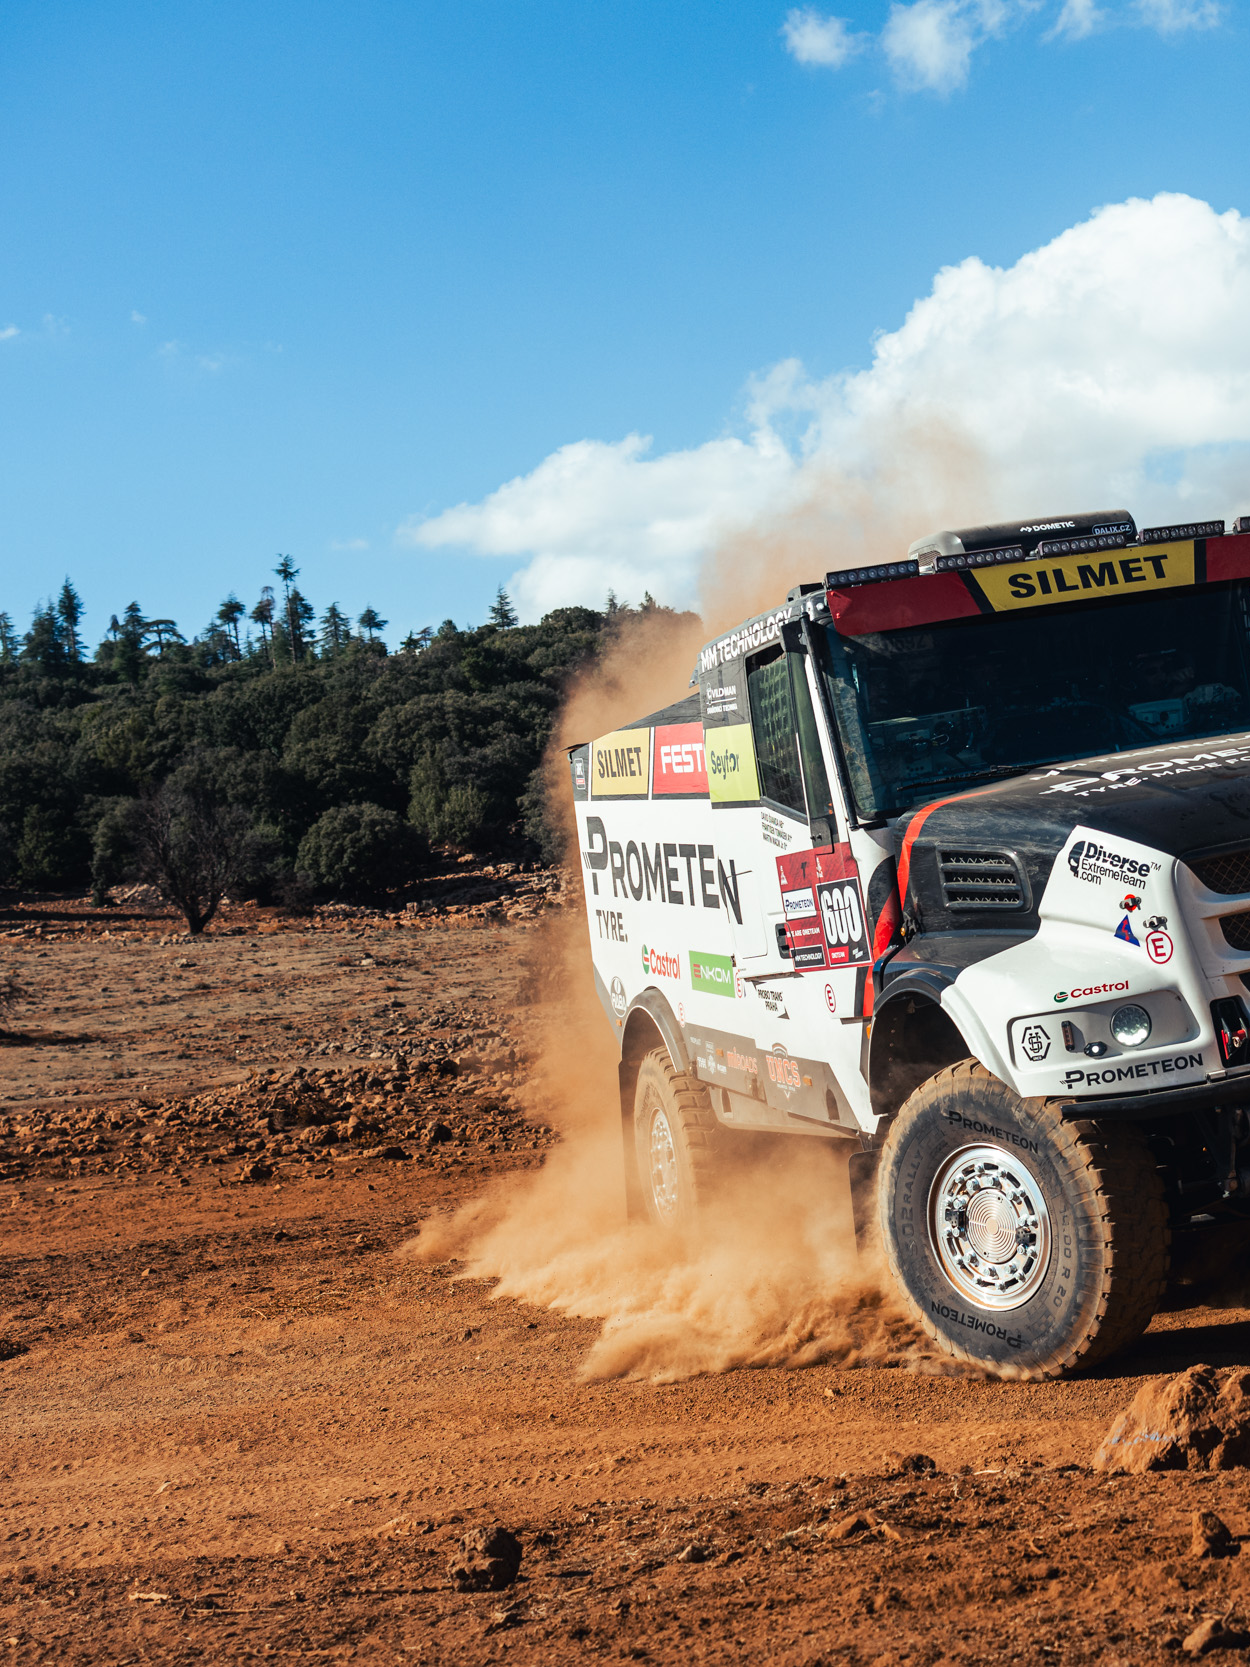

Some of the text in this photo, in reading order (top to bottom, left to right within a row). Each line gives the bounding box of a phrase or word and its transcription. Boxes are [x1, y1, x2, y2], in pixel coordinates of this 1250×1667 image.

[1033, 520, 1076, 532] DOMETIC
[1094, 524, 1131, 536] DALIX.CZ
[1008, 554, 1168, 599] SILMET
[700, 647, 718, 673] MM
[597, 746, 643, 779] SILMET
[660, 743, 708, 774] FEST
[1074, 777, 1149, 797] TYRE.
[1152, 761, 1222, 778] MADE
[1081, 858, 1147, 890] ExtremeTeam
[1084, 841, 1151, 877] Diverse
[1080, 871, 1102, 886] .com
[785, 898, 813, 911] PROMETEON
[820, 885, 863, 945] 600
[596, 909, 629, 943] TYRE.
[1151, 937, 1167, 958] E
[650, 948, 681, 980] Castrol
[693, 963, 732, 985] ENKOM
[827, 988, 834, 1007] E
[1070, 980, 1129, 999] Castrol
[766, 1055, 801, 1088] UNCS
[1059, 1053, 1204, 1090] PROMETEON
[947, 1111, 1039, 1154] PROMETEON
[1061, 1266, 1071, 1280] R
[1053, 1284, 1067, 1308] 20
[931, 1301, 1025, 1349] PROMETEON
